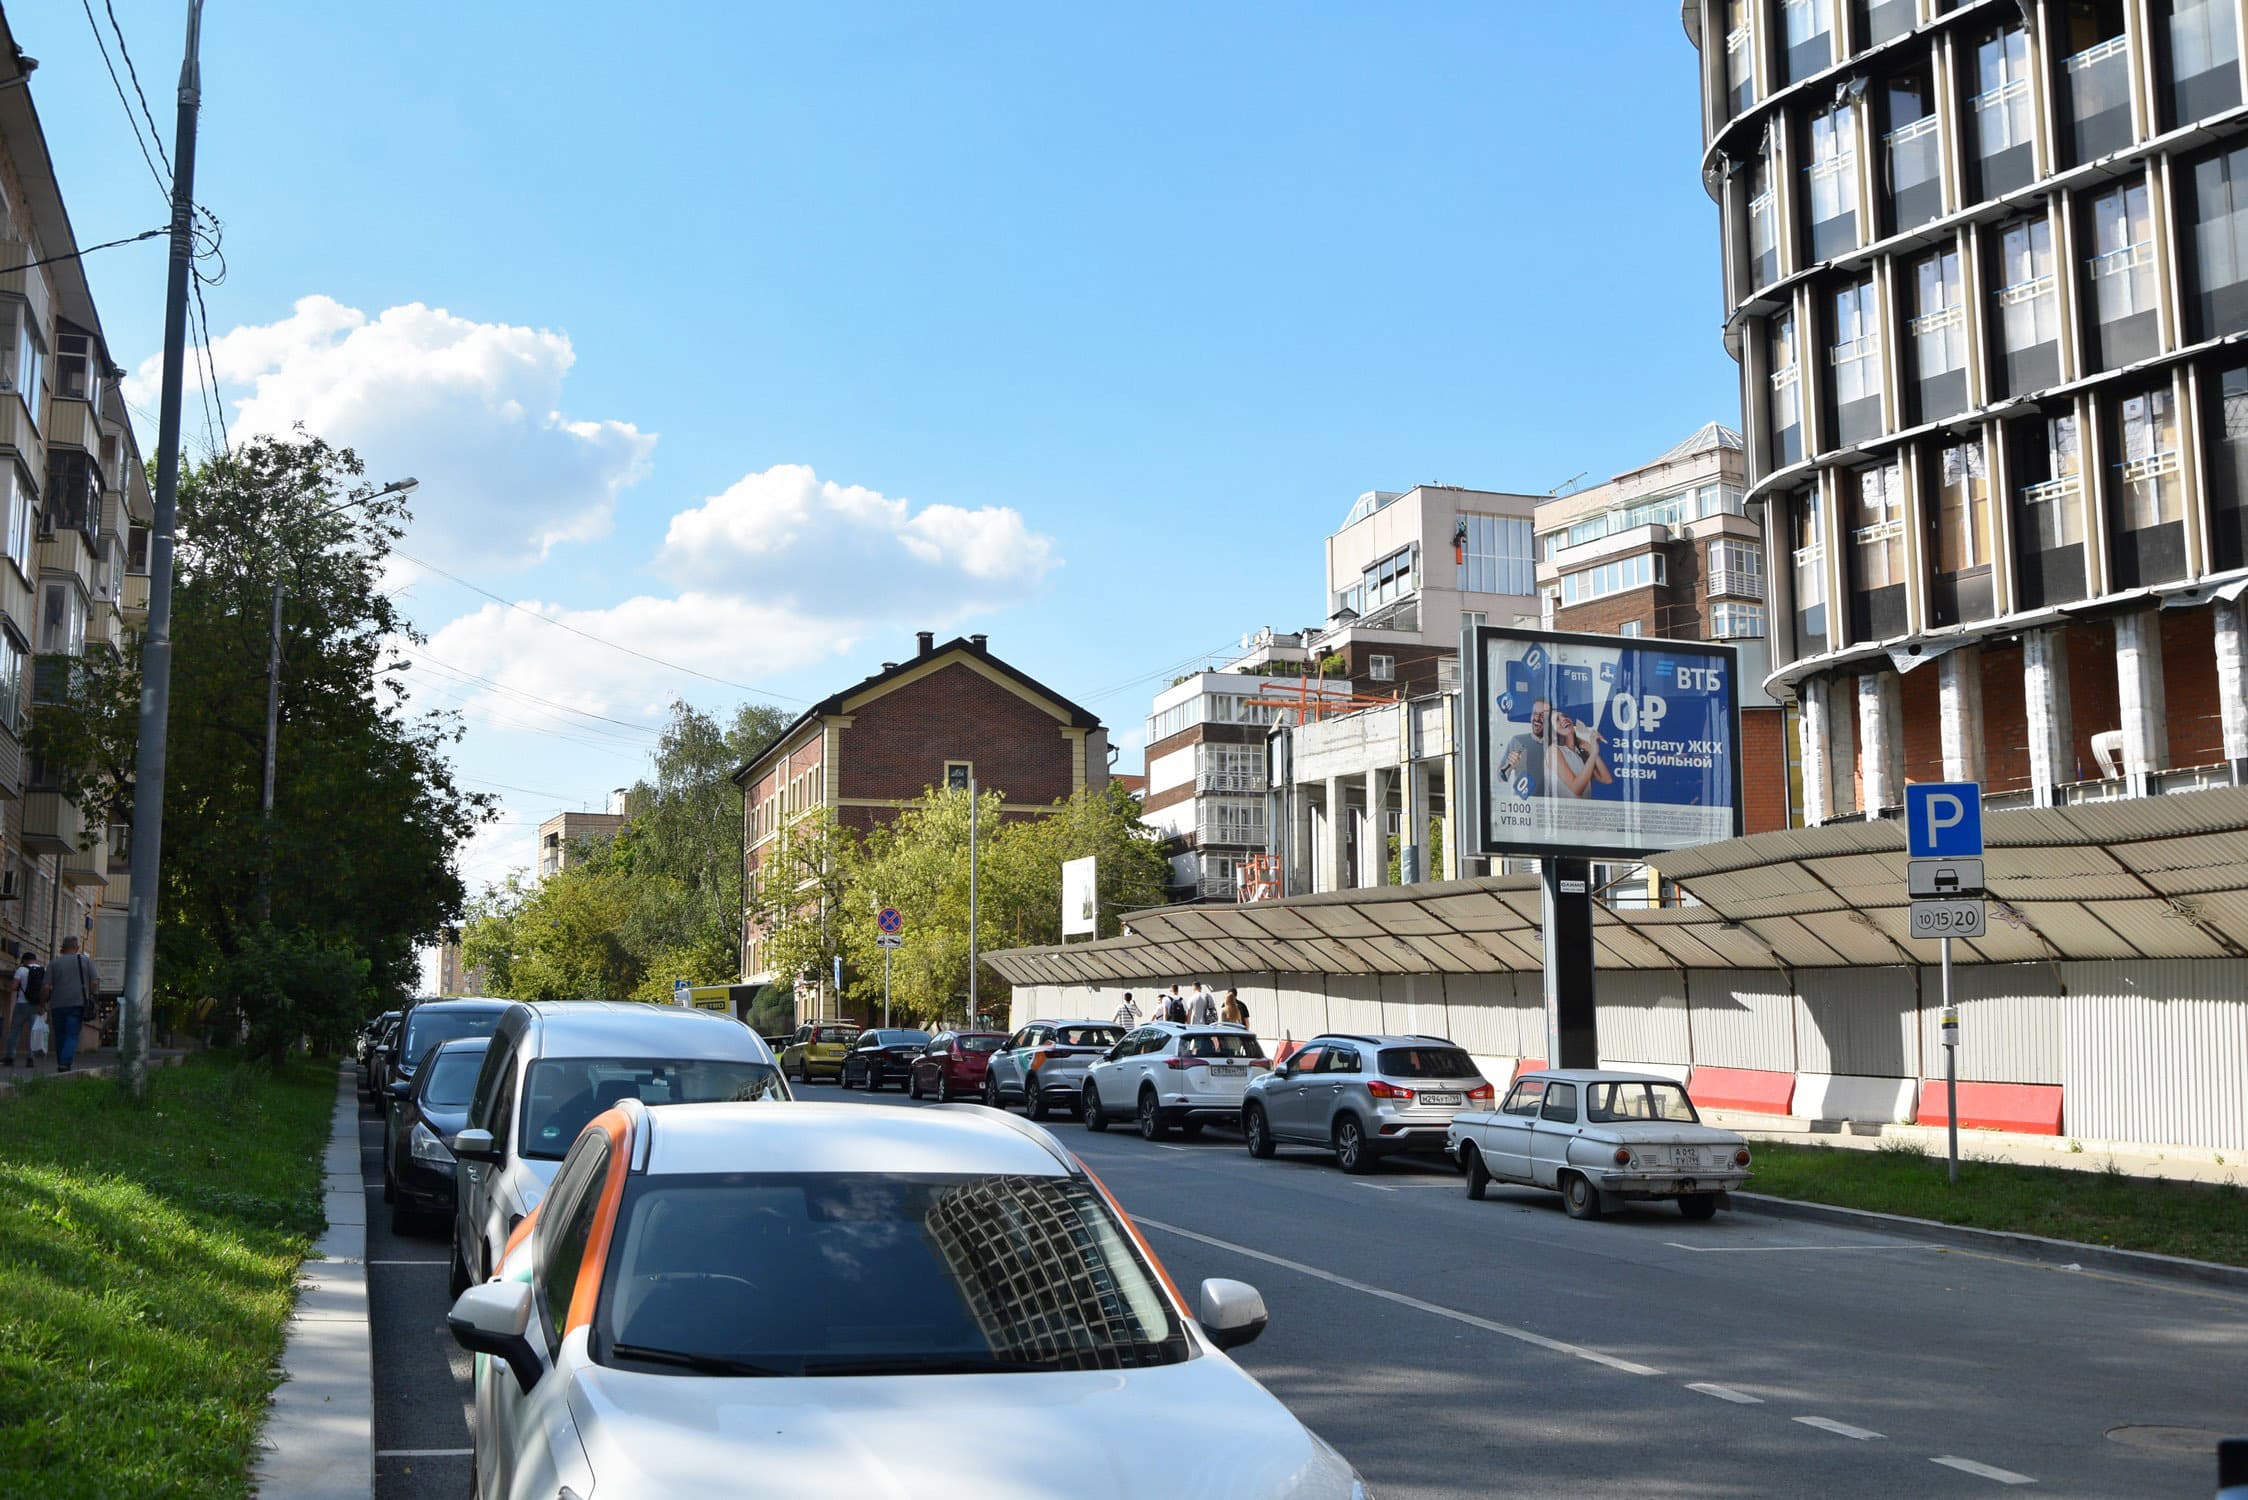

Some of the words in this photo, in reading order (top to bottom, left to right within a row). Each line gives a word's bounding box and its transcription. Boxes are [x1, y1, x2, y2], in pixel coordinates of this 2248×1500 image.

[1677, 666, 1720, 691] ВТБ
[1612, 738, 1630, 749] за
[1633, 739, 1684, 756] оплату
[1688, 740, 1723, 754] ЖКХ
[1613, 752, 1623, 763] и
[1627, 752, 1713, 769] мобильной
[1614, 767, 1657, 780] связи
[1508, 803, 1531, 814] 1000
[1500, 815, 1532, 826] VTB.RU
[1926, 793, 1964, 848] P
[1919, 914, 1932, 925] 10
[1935, 912, 1949, 926] 15
[1954, 910, 1976, 926] 20
